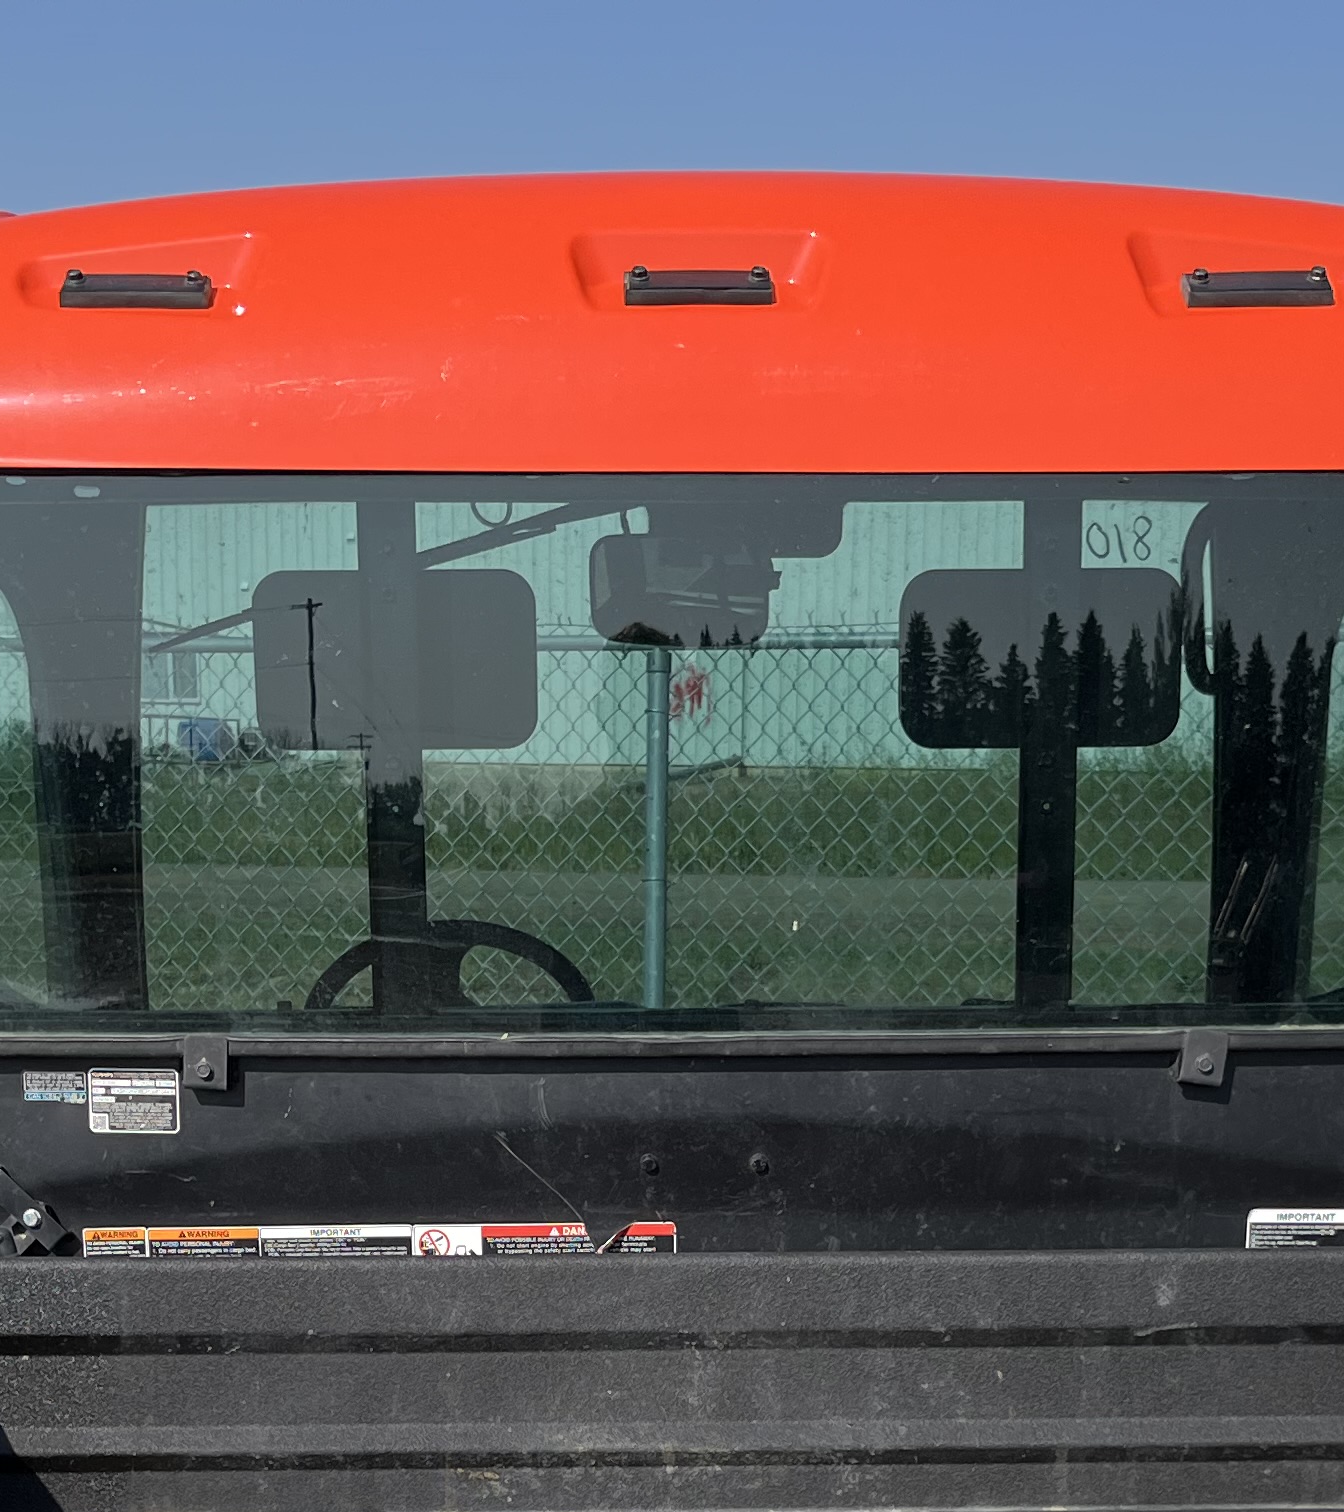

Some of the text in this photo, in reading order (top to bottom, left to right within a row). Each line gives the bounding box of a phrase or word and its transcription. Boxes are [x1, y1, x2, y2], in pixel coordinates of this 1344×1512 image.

[1085, 514, 1153, 564] 018
[1276, 1213, 1337, 1222] IMPORTANT
[187, 1230, 230, 1238] WARNING
[310, 1228, 362, 1237] IMPORTANT
